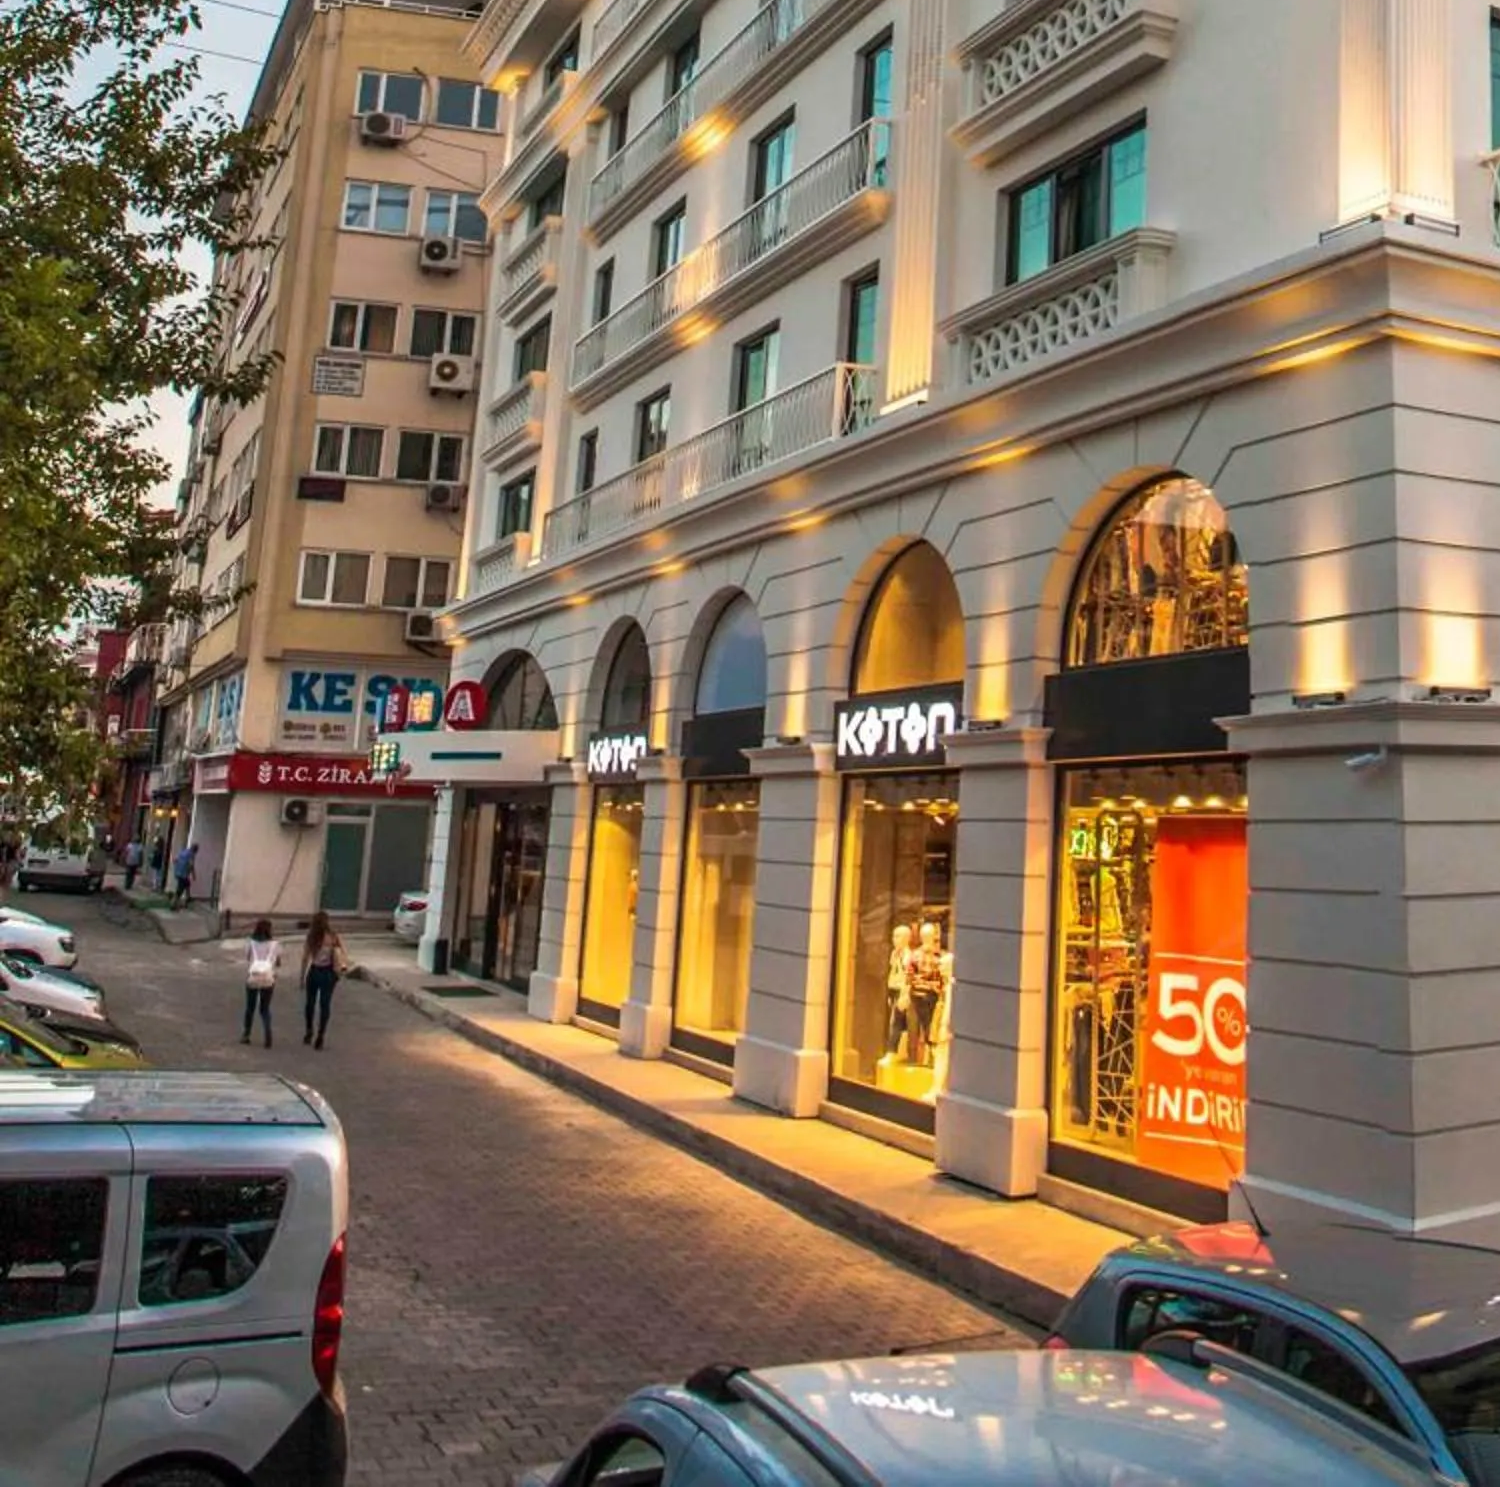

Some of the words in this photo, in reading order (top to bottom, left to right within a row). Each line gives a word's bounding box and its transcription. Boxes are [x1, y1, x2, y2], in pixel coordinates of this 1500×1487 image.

[837, 702, 955, 756] KOTON
[277, 766, 313, 783] T.C.
[317, 765, 377, 785] ZİRA
[1151, 973, 1246, 1066] 50
